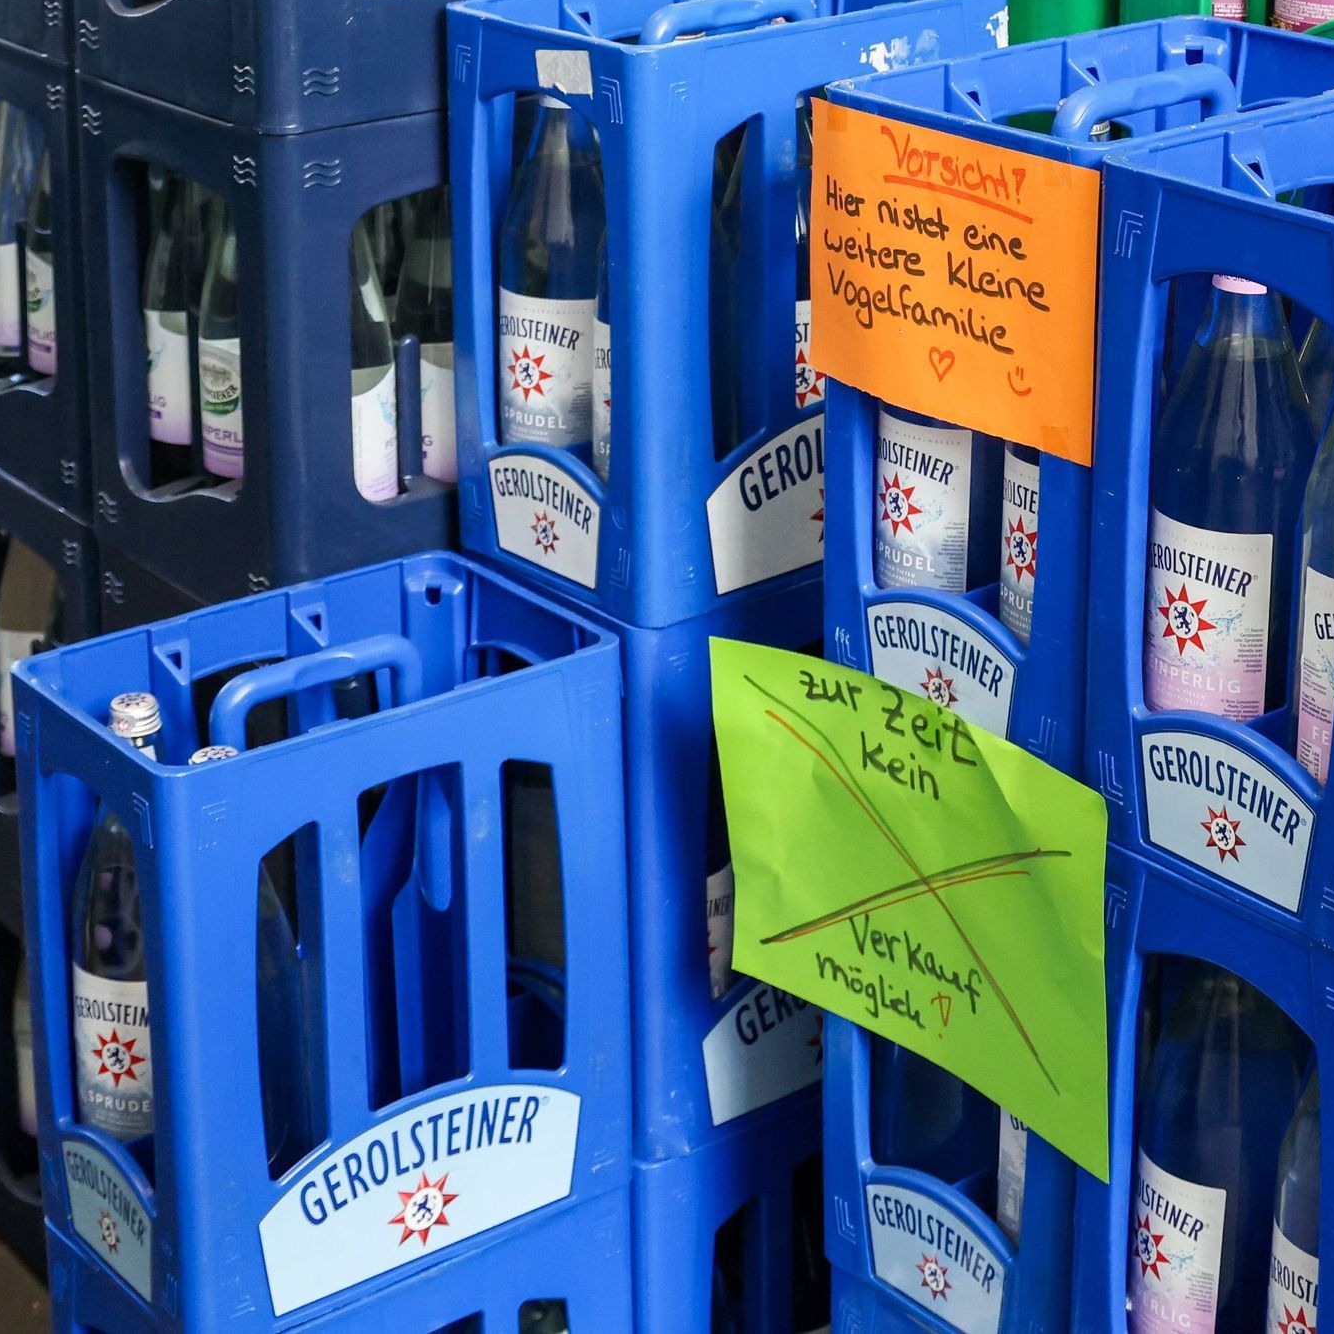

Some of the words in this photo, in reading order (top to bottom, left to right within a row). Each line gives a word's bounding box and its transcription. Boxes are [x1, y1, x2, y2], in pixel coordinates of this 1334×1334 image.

[880, 125, 1026, 206] Vorsicht!
[824, 227, 926, 277] weitere
[825, 174, 865, 217] Hier
[877, 198, 950, 241] nistet
[963, 223, 1028, 260] eine
[827, 262, 1015, 355] Vogelfamilie
[504, 405, 568, 430] SPRUDEL
[494, 466, 593, 536] GEROLSTEINER
[878, 540, 936, 573] PRUDEL
[874, 615, 1005, 698] GEROLSTEINER
[880, 683, 978, 768] Zeit
[1148, 743, 1301, 846] GEROLSTEINER
[848, 913, 983, 1015] Verkauf
[87, 1088, 152, 1113] SPRUDE
[66, 1151, 146, 1247] GEROLSTEINER
[300, 1095, 539, 1227] GEROLSTEINER
[873, 1196, 997, 1295] GEROLSTEINER
